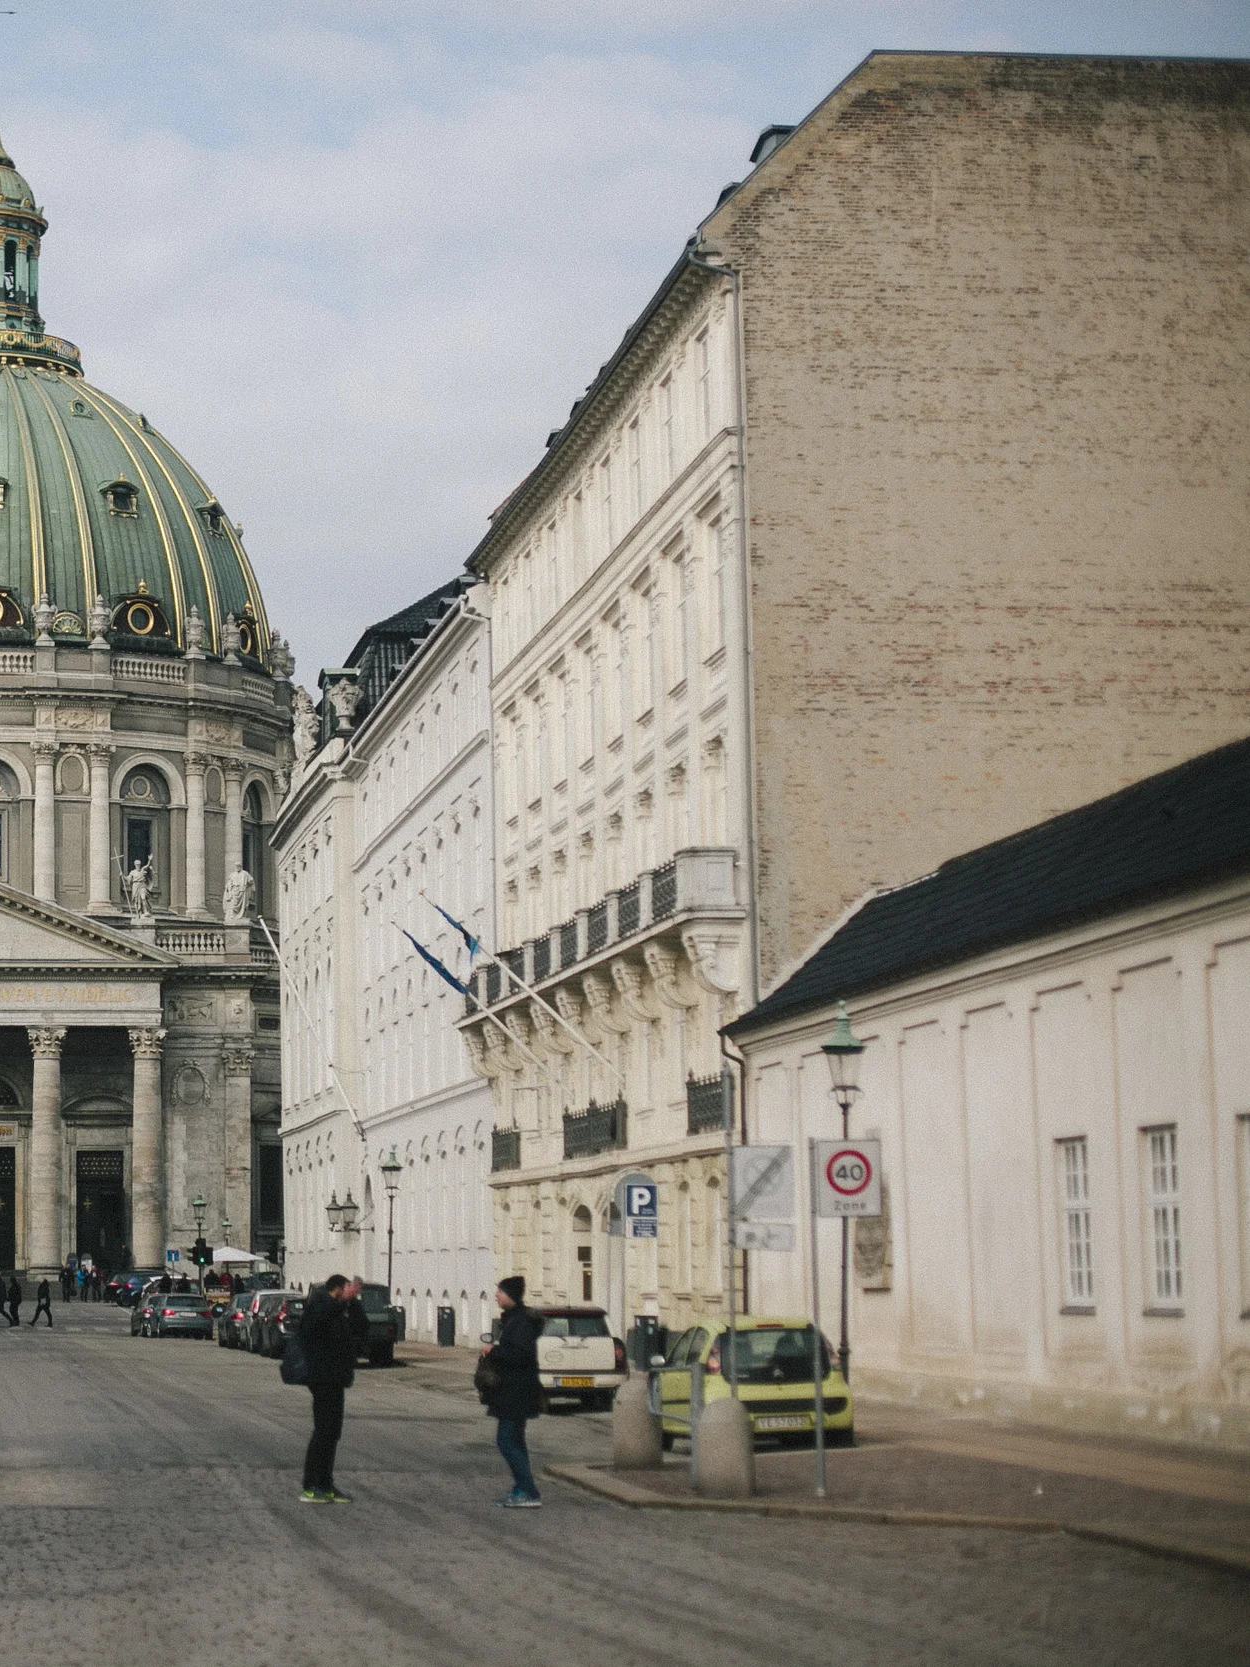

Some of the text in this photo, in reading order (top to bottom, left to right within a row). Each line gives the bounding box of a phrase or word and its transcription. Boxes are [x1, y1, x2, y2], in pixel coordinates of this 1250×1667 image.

[836, 1164, 863, 1181] 40
[631, 1186, 652, 1215] P
[834, 1200, 867, 1211] Zone
